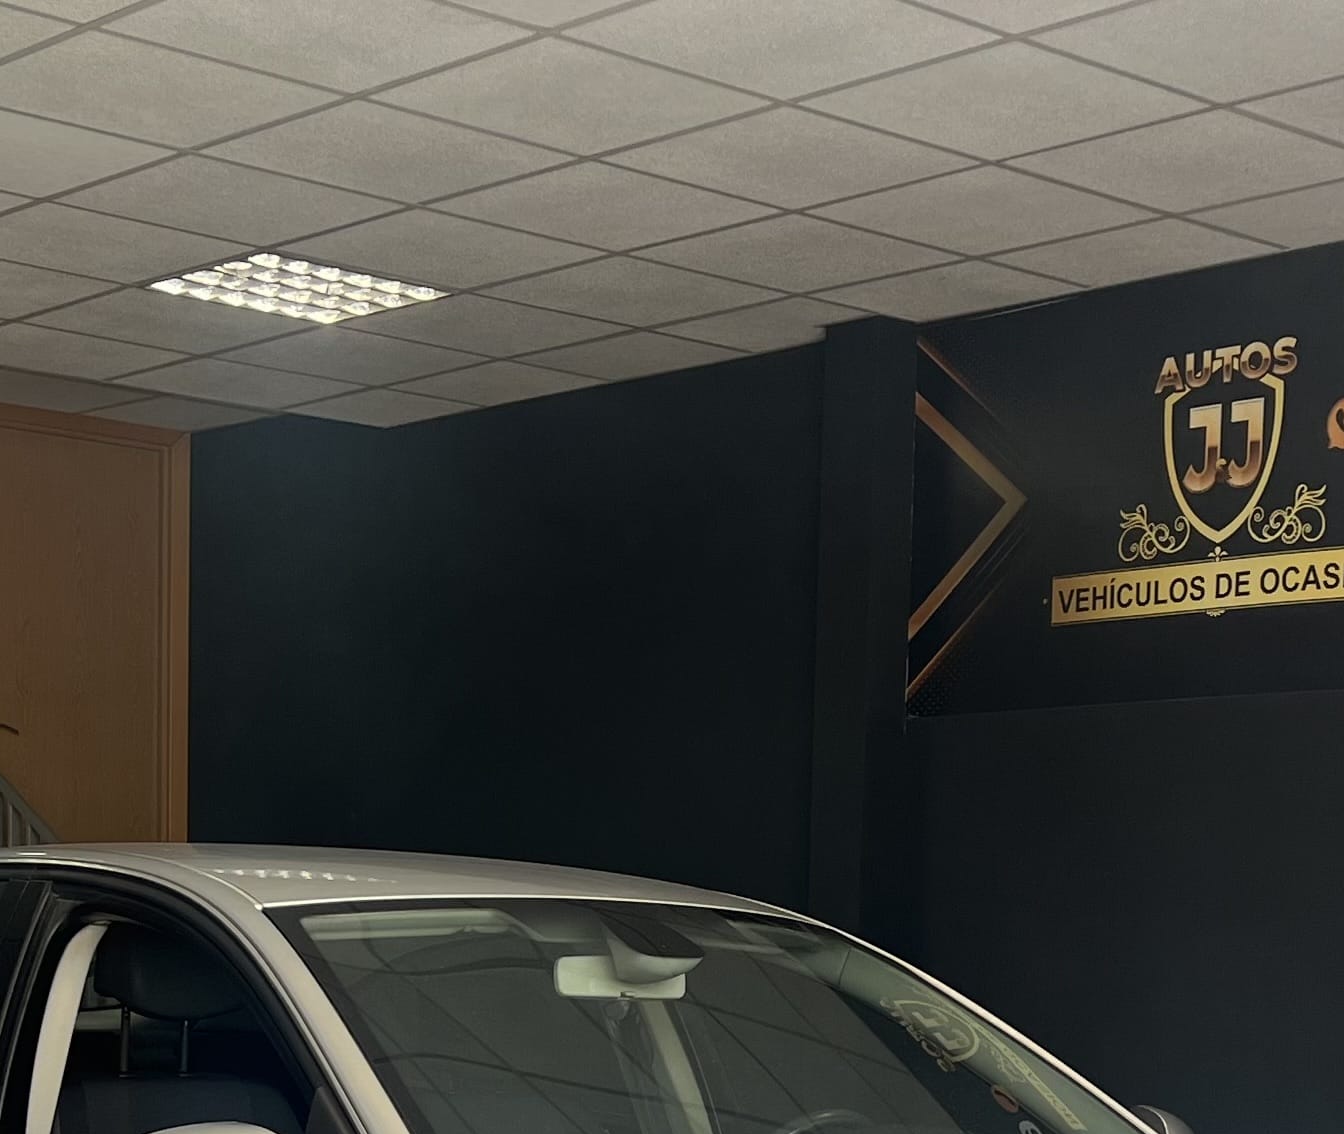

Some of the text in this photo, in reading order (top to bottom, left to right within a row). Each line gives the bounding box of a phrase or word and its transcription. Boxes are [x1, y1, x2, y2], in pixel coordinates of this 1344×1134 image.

[1154, 336, 1298, 394] AUTOS
[1058, 576, 1206, 614] VEHÍCULOS
[1214, 570, 1251, 599] DE
